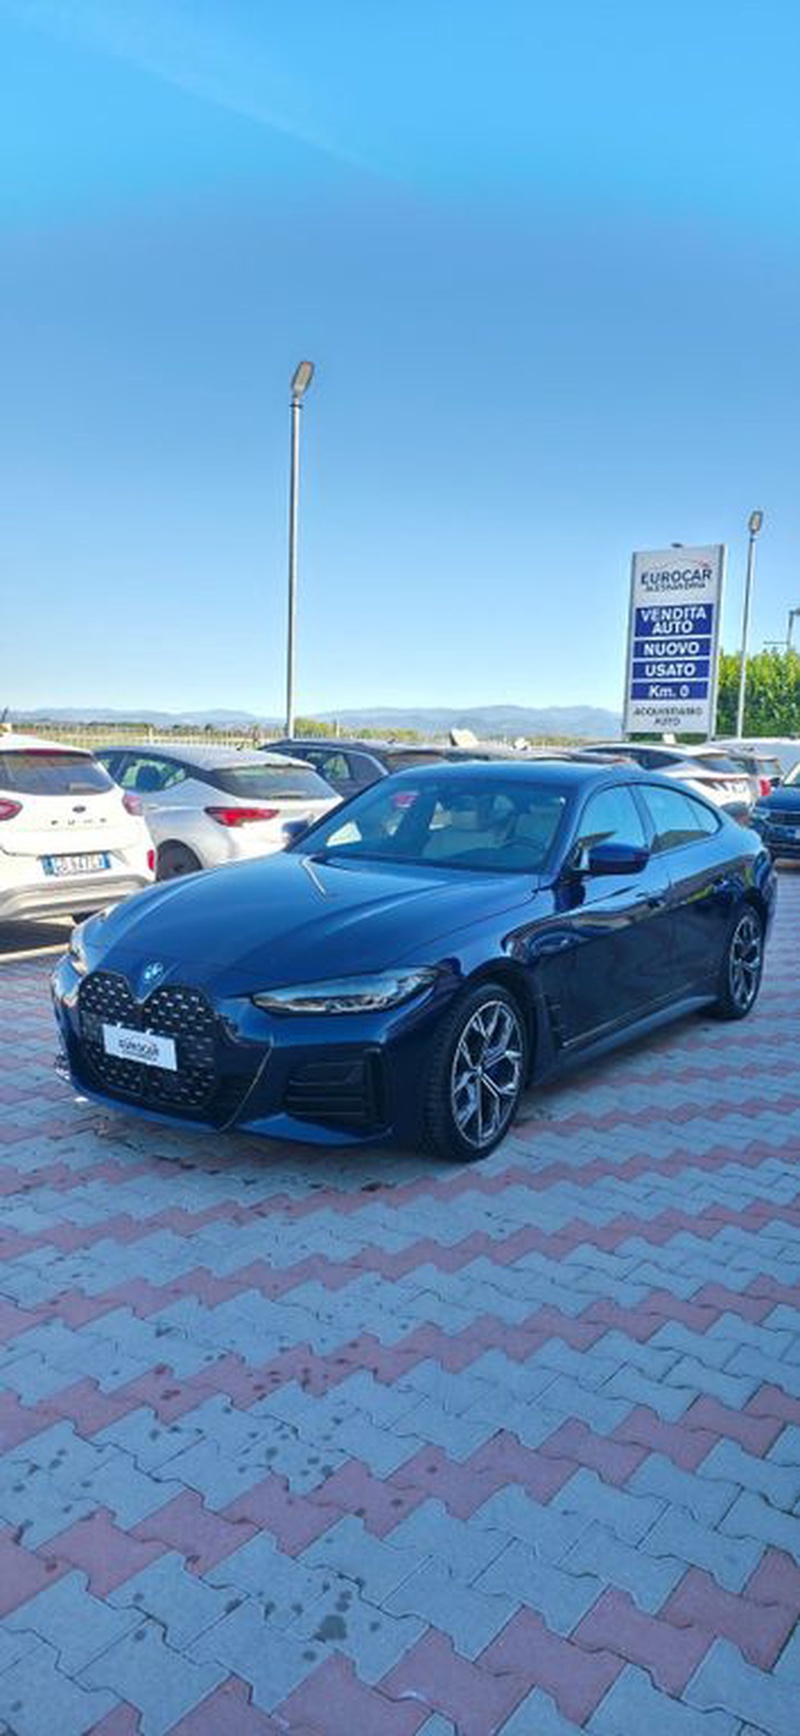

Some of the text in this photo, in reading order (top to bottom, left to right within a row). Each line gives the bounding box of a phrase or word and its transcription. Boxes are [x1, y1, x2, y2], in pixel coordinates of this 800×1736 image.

[641, 569, 712, 585] EUROCAR
[641, 607, 707, 621] VENDITA
[652, 620, 694, 634] AUTO
[643, 642, 700, 657] NUOVO
[645, 663, 696, 678] USATO
[649, 684, 690, 698] Km. 0
